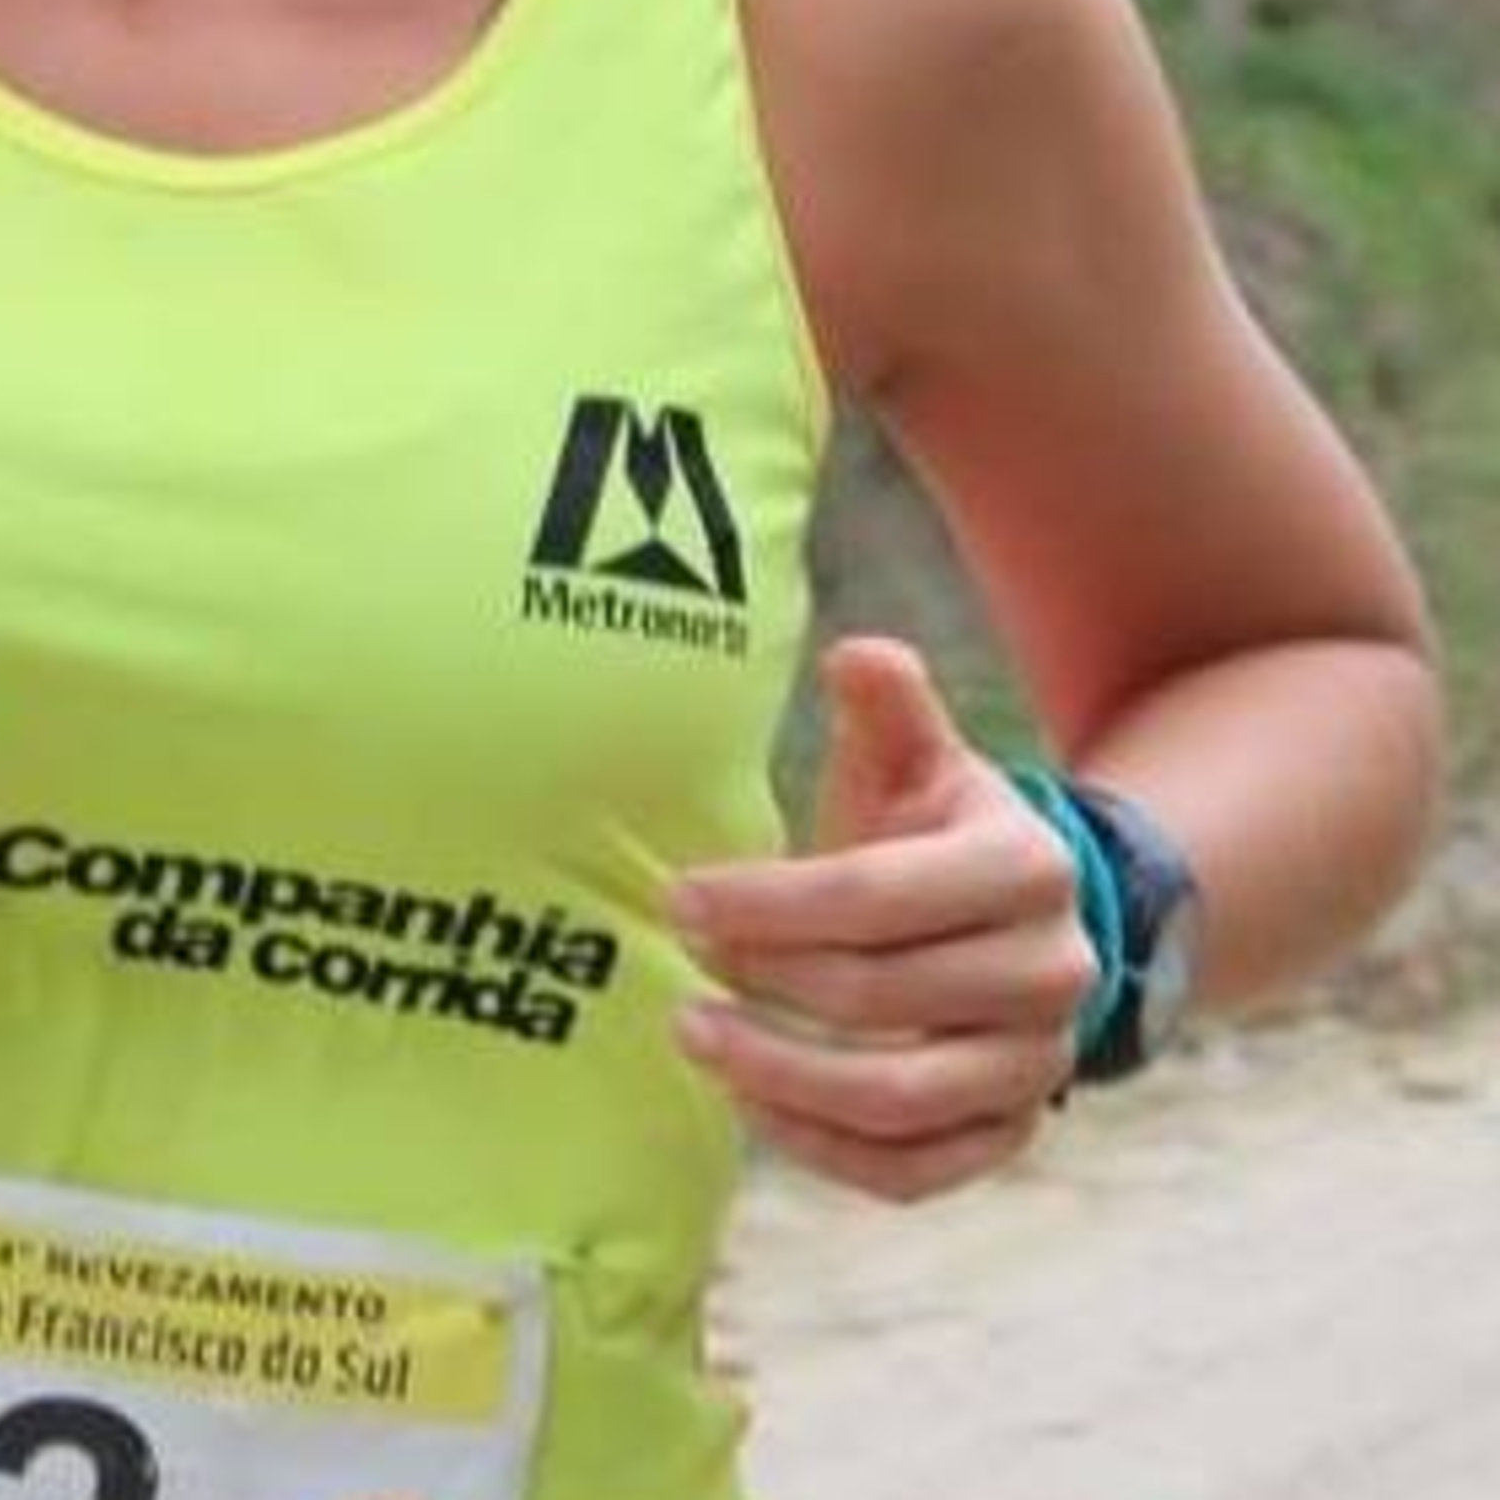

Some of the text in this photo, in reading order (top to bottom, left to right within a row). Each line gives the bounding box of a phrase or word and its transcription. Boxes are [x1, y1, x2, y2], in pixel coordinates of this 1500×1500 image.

[113, 904, 577, 1045] da corrida
[16, 1293, 248, 1377] Francisco
[259, 1330, 322, 1389] do
[335, 1342, 410, 1401] Sul
